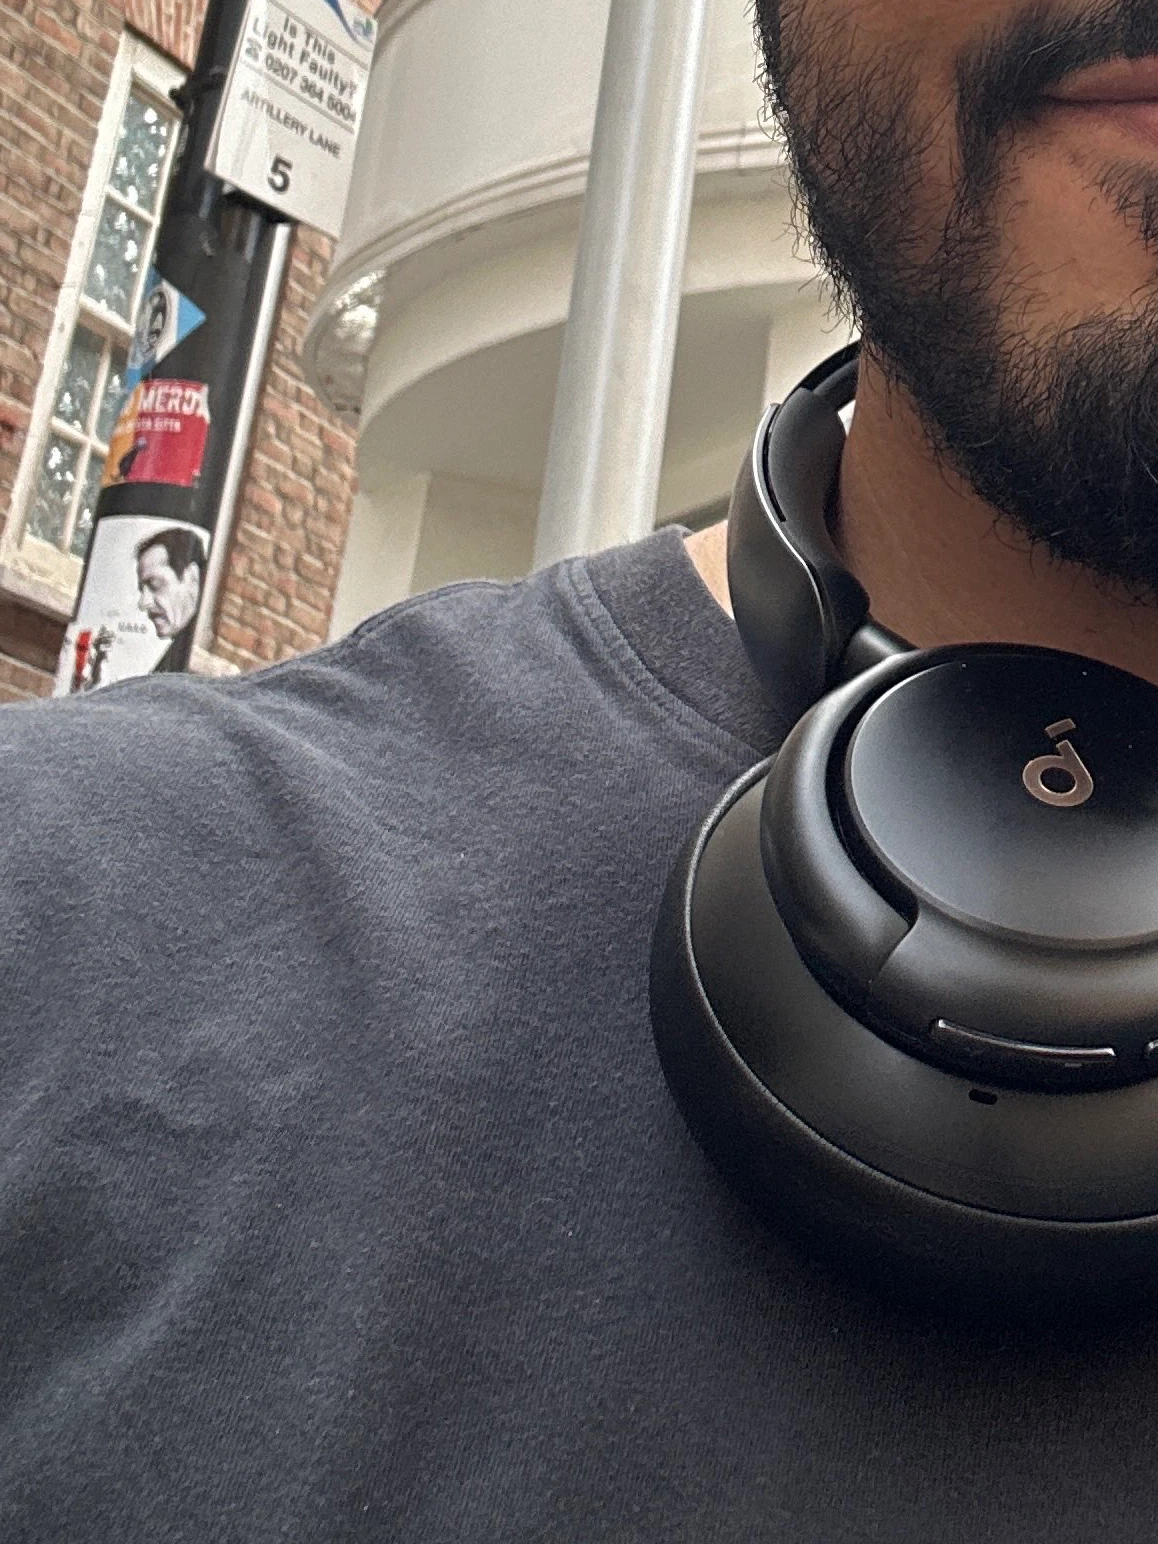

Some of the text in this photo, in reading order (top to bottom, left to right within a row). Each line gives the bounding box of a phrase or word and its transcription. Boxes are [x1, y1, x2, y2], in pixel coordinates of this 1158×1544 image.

[252, 17, 357, 99] Light Faulty?
[305, 29, 336, 65] This
[241, 88, 341, 158] ARTILLERY LANE
[267, 156, 293, 194] 5
